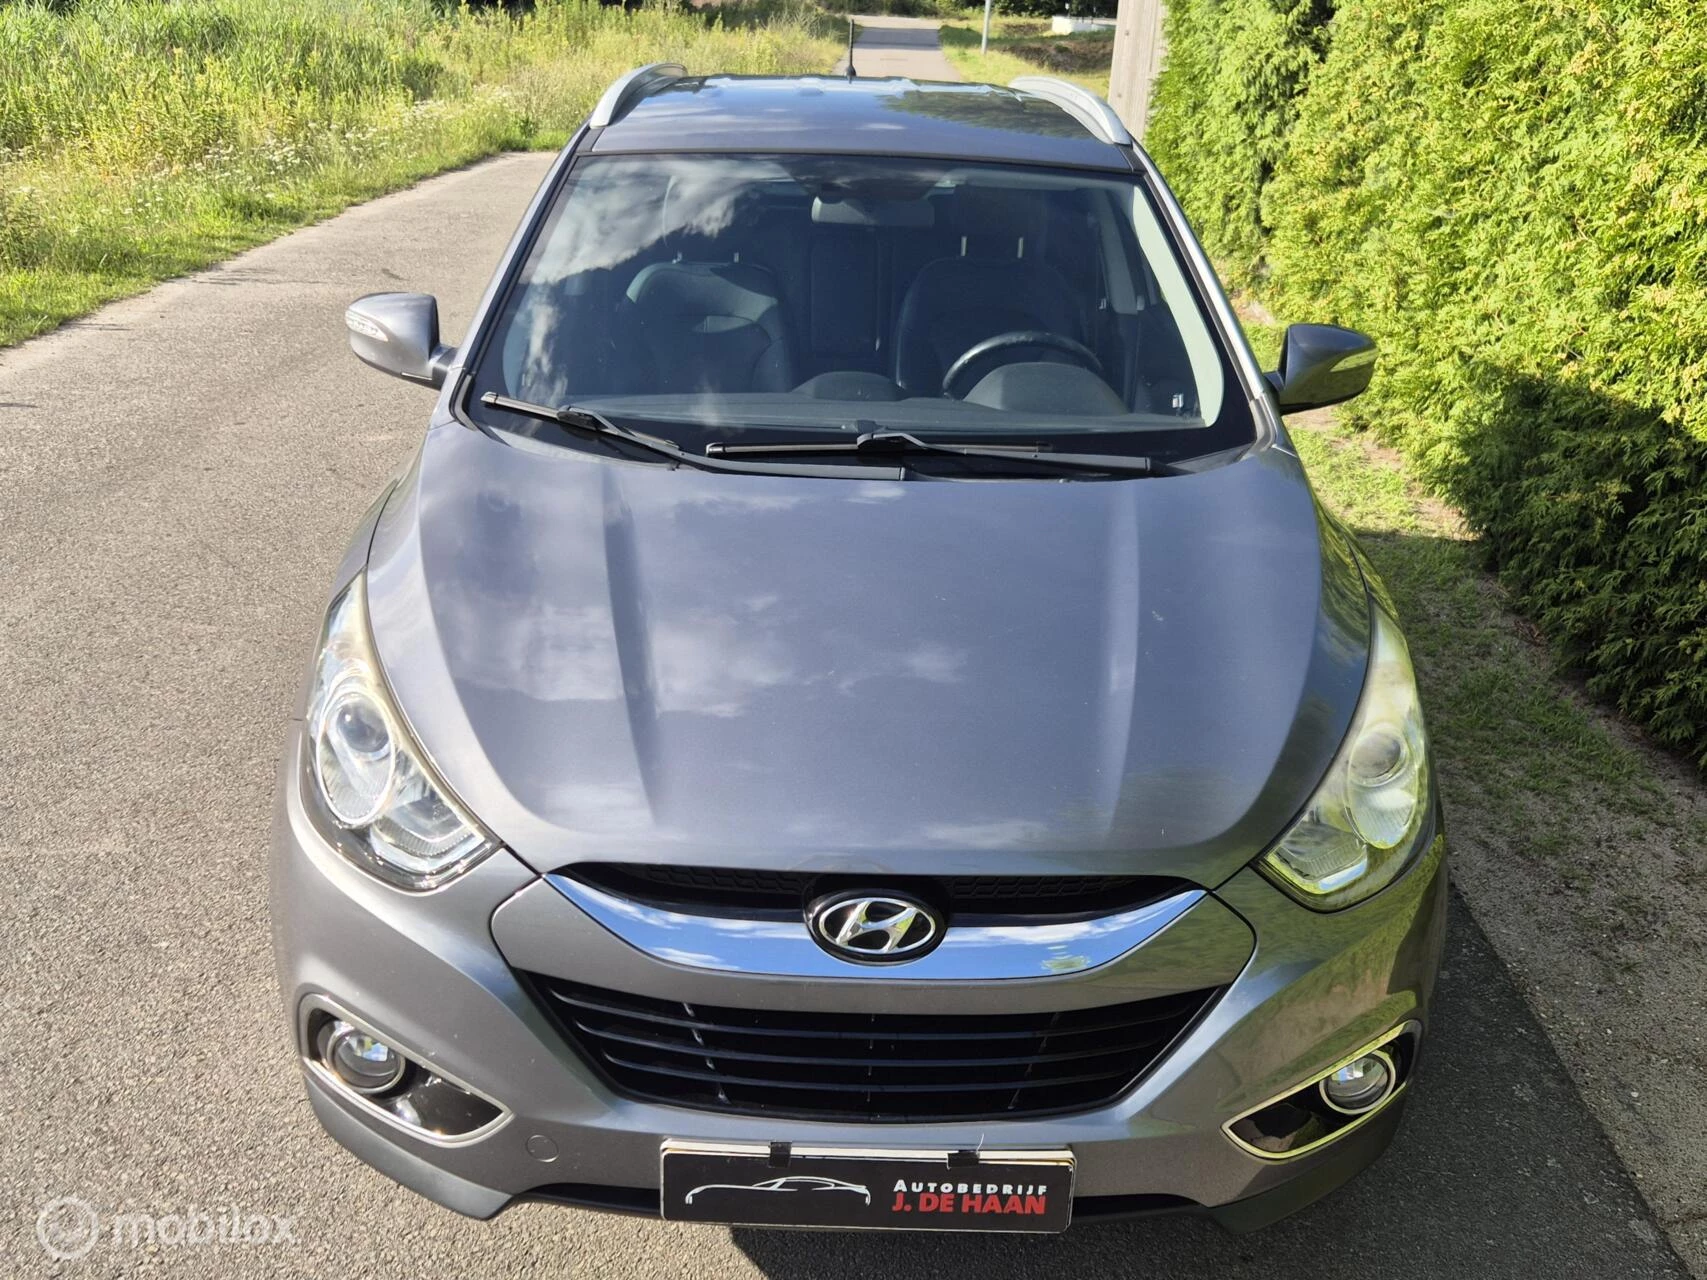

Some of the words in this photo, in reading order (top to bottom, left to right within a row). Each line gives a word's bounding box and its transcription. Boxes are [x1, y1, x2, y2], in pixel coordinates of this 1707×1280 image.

[893, 1179, 1047, 1195] AUTOBEDRIJF
[892, 1193, 912, 1212] J.
[919, 1193, 954, 1213] DE
[961, 1194, 1046, 1215] HAAN
